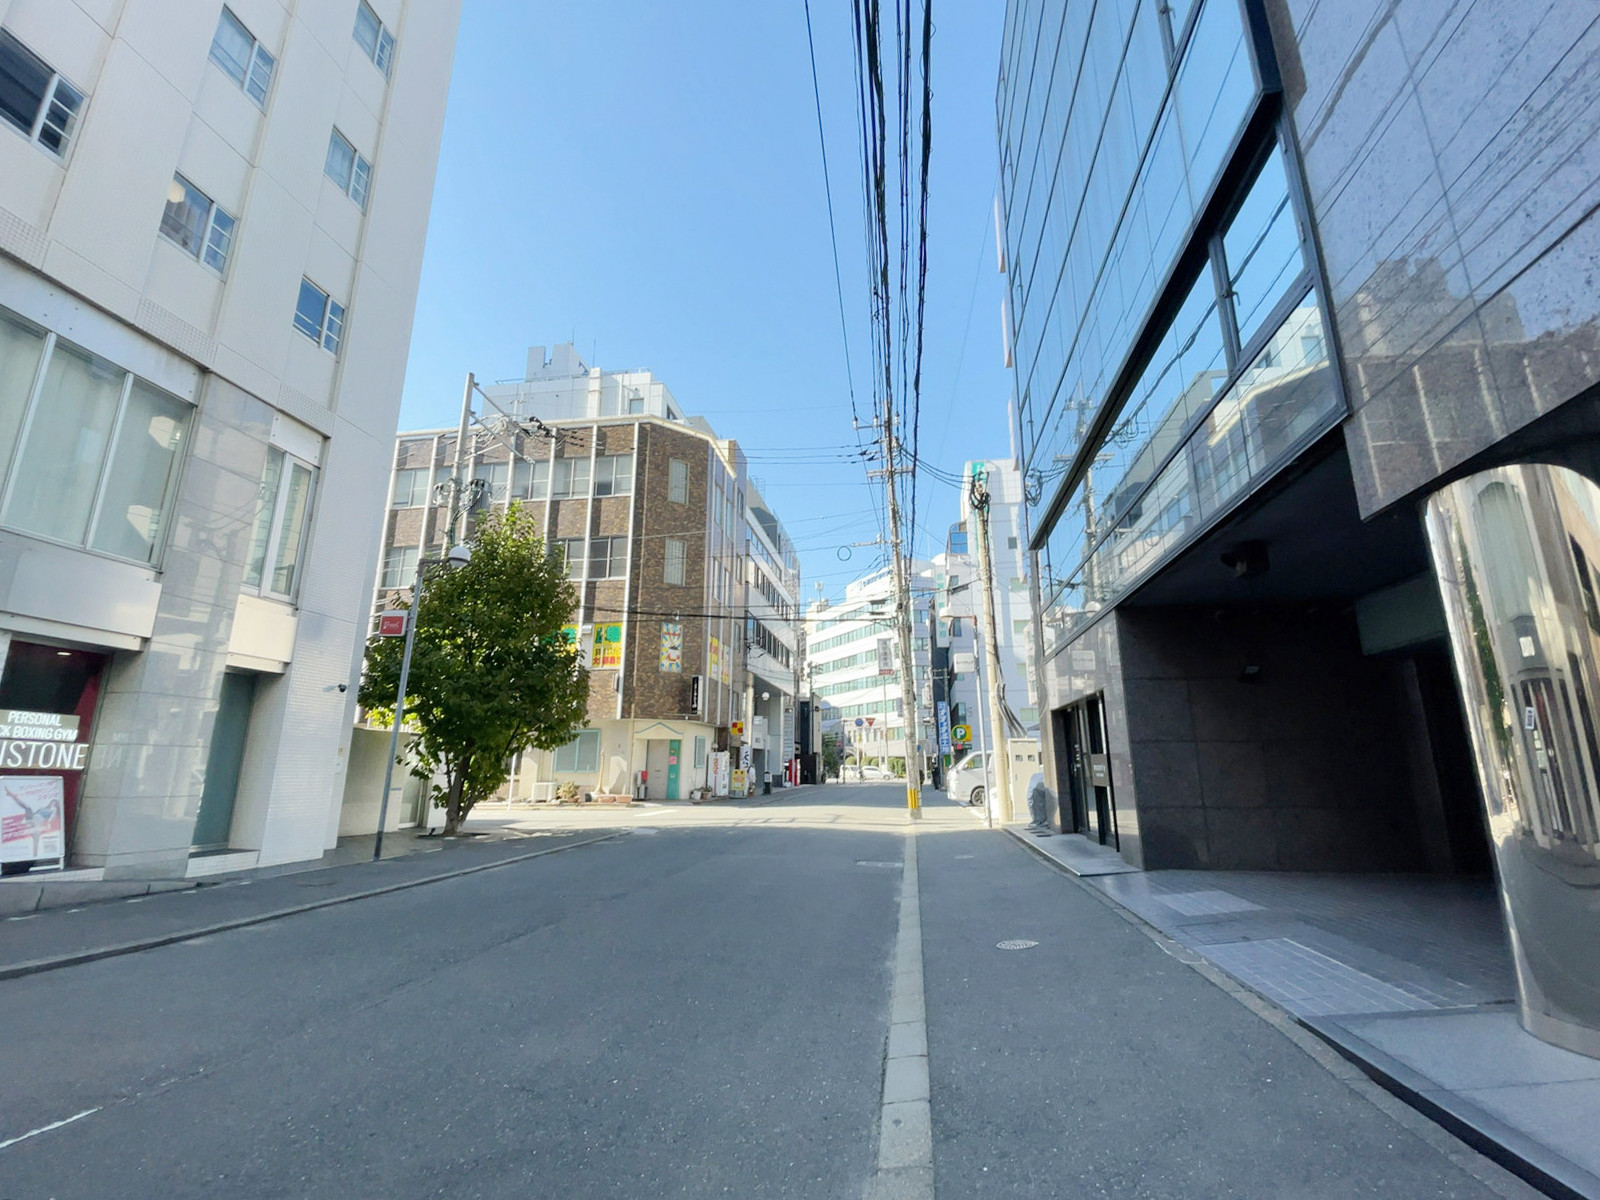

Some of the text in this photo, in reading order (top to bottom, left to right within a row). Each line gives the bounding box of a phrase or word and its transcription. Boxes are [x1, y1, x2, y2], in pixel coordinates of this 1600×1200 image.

[8, 711, 62, 726] PERSONAL
[12, 727, 53, 740] BOXING
[54, 729, 78, 742] GYM
